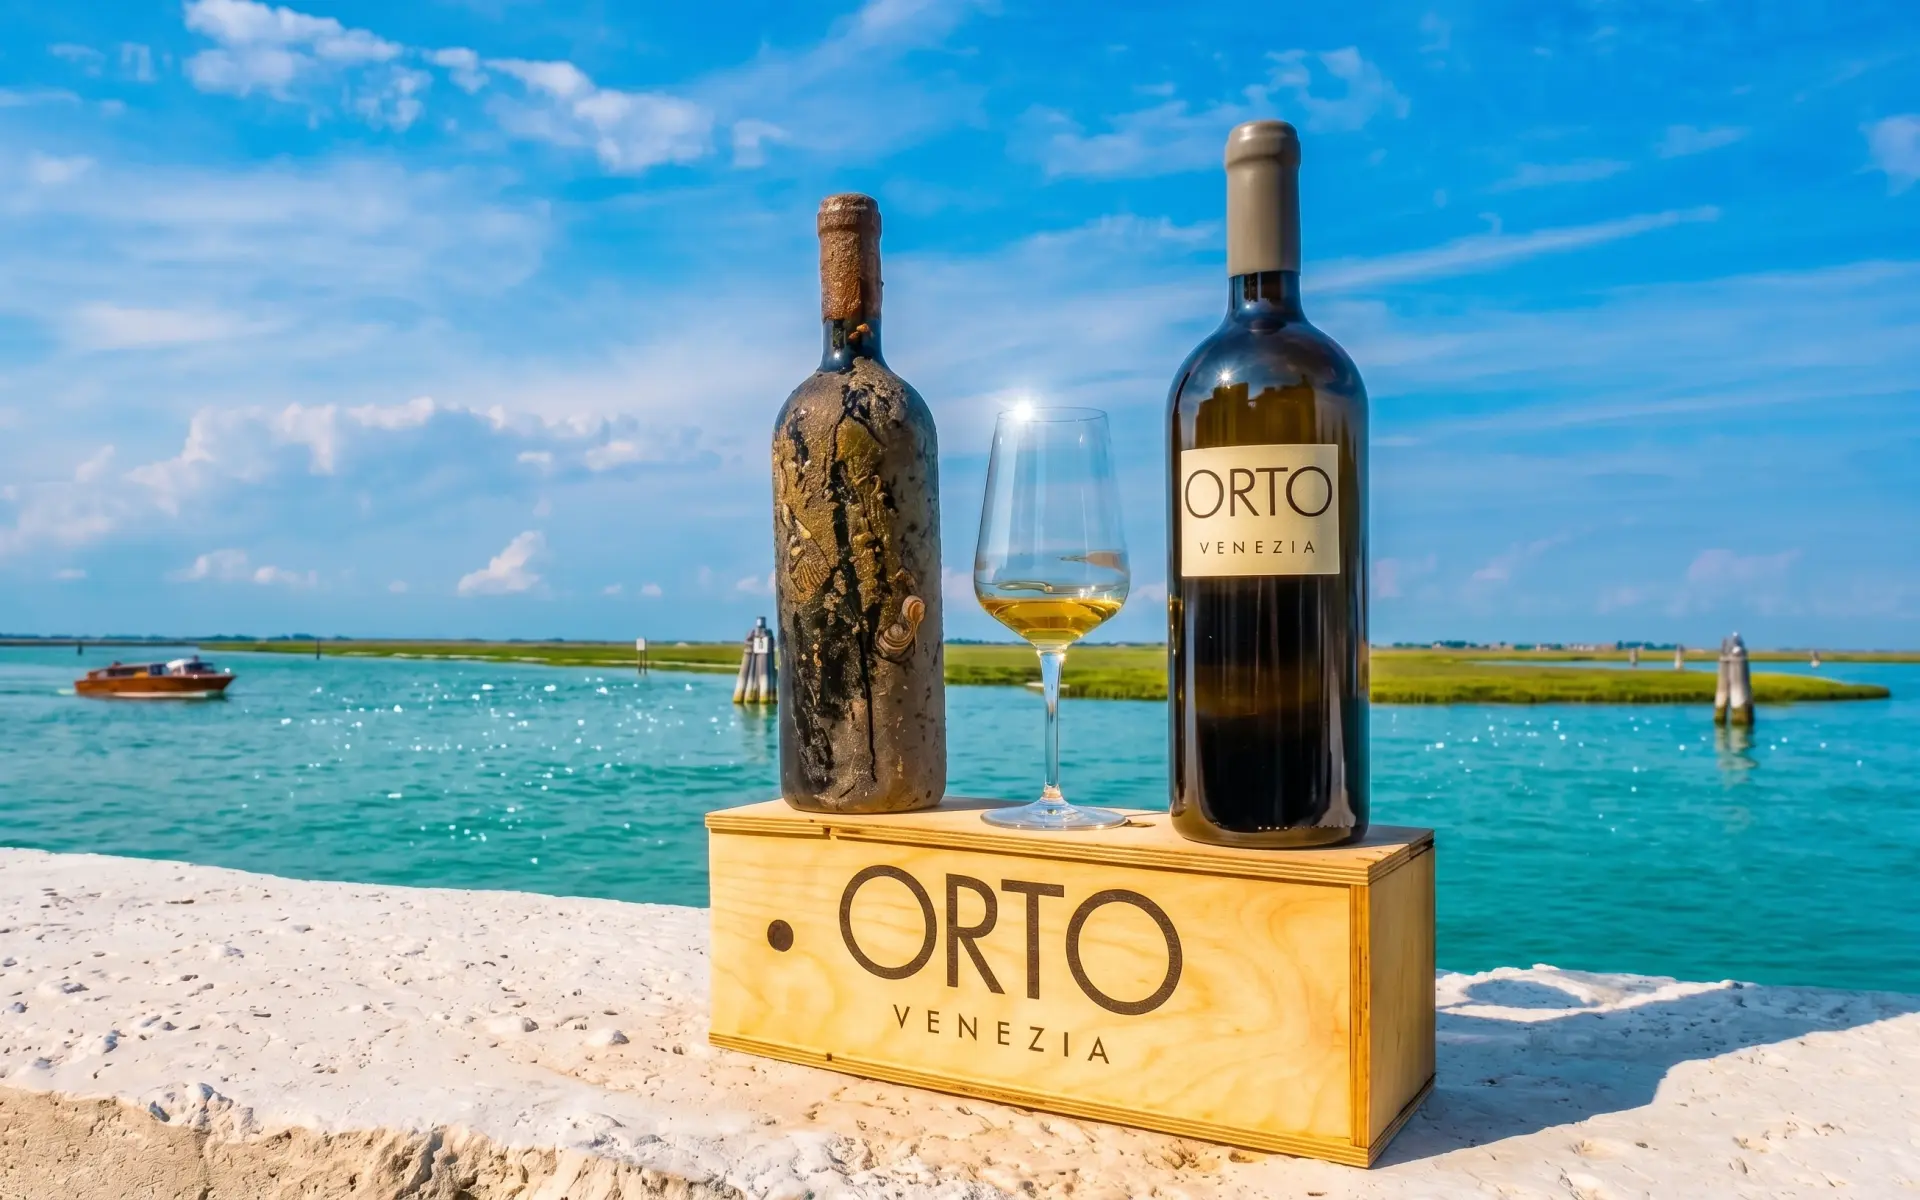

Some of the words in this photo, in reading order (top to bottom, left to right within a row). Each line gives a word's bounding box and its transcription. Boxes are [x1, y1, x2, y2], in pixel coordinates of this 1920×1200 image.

[1185, 466, 1333, 518] ORTO
[1200, 540, 1315, 555] VENEZIA
[838, 864, 1183, 1016] ORTO
[893, 1004, 1110, 1064] VENEZIA
